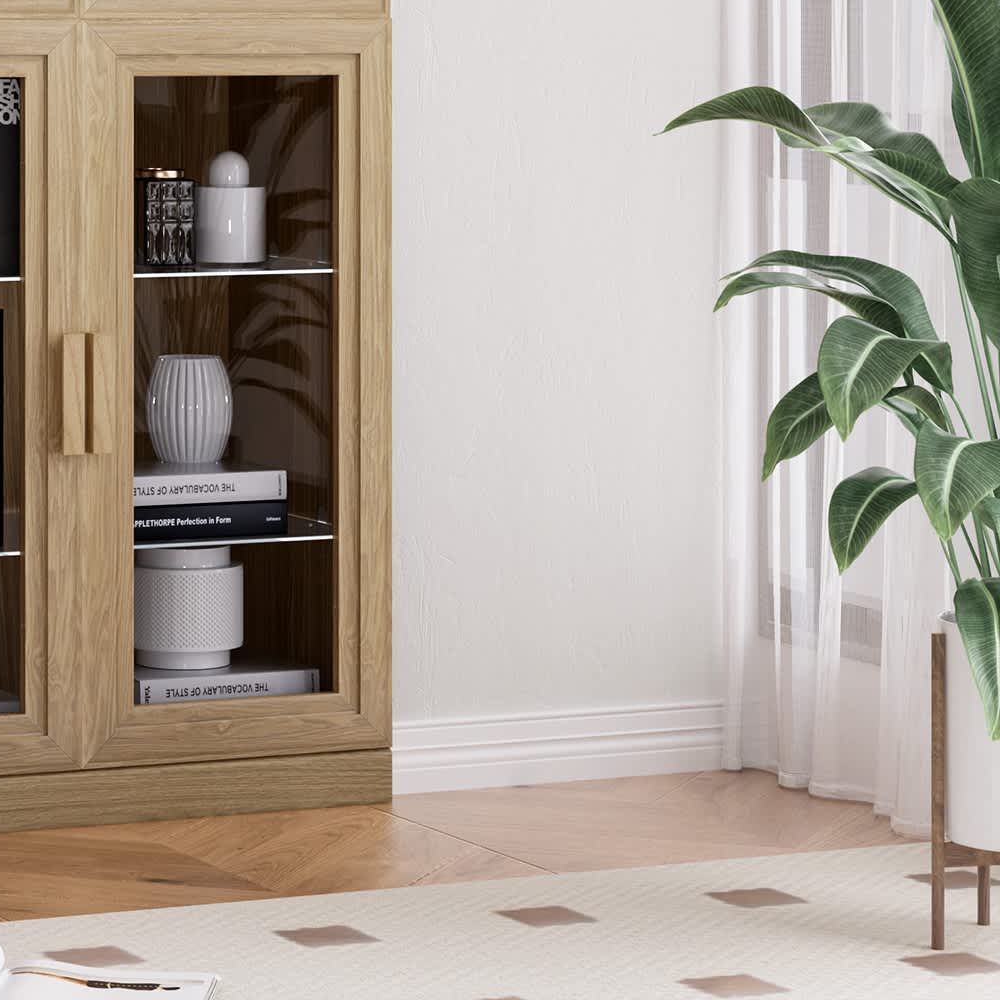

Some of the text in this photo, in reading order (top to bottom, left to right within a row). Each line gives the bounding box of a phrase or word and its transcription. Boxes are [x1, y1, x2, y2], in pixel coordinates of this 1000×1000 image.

[156, 486, 168, 496] OF
[169, 483, 220, 496] VOCABULARY
[221, 483, 235, 493] THE
[134, 516, 232, 528] PPLETHORPE Perfection in Form
[165, 683, 269, 699] THE VOCABULARY OF STYLE
